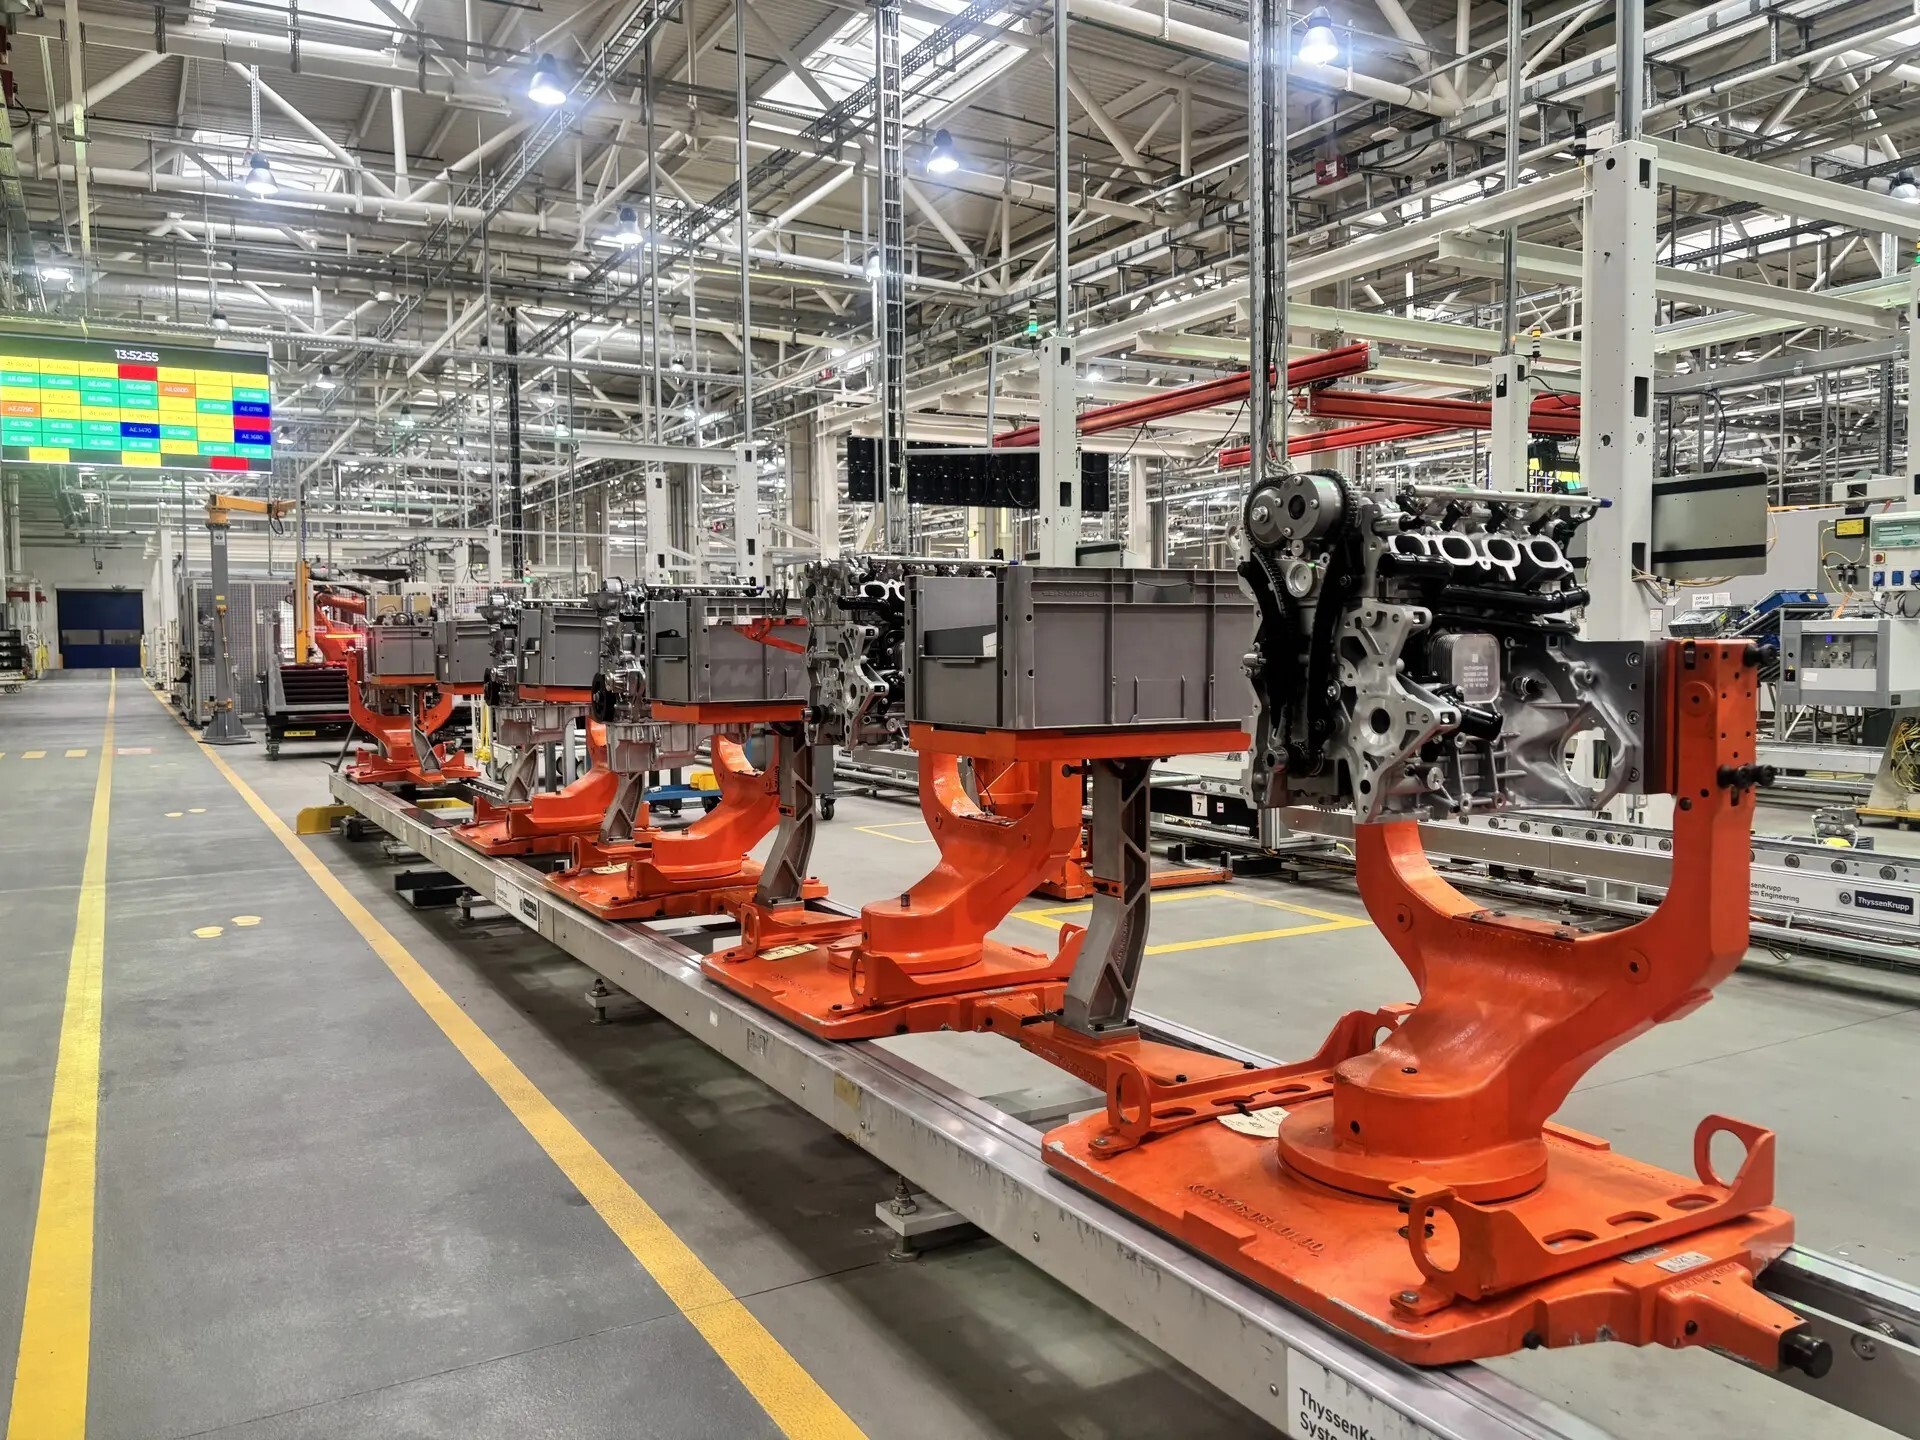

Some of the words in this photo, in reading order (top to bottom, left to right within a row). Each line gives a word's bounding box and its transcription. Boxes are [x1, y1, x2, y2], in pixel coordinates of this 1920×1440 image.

[115, 349, 158, 362] 13:52:55
[1761, 890, 1800, 903] Engineering
[1857, 896, 1910, 911] ThyssenKrupp
